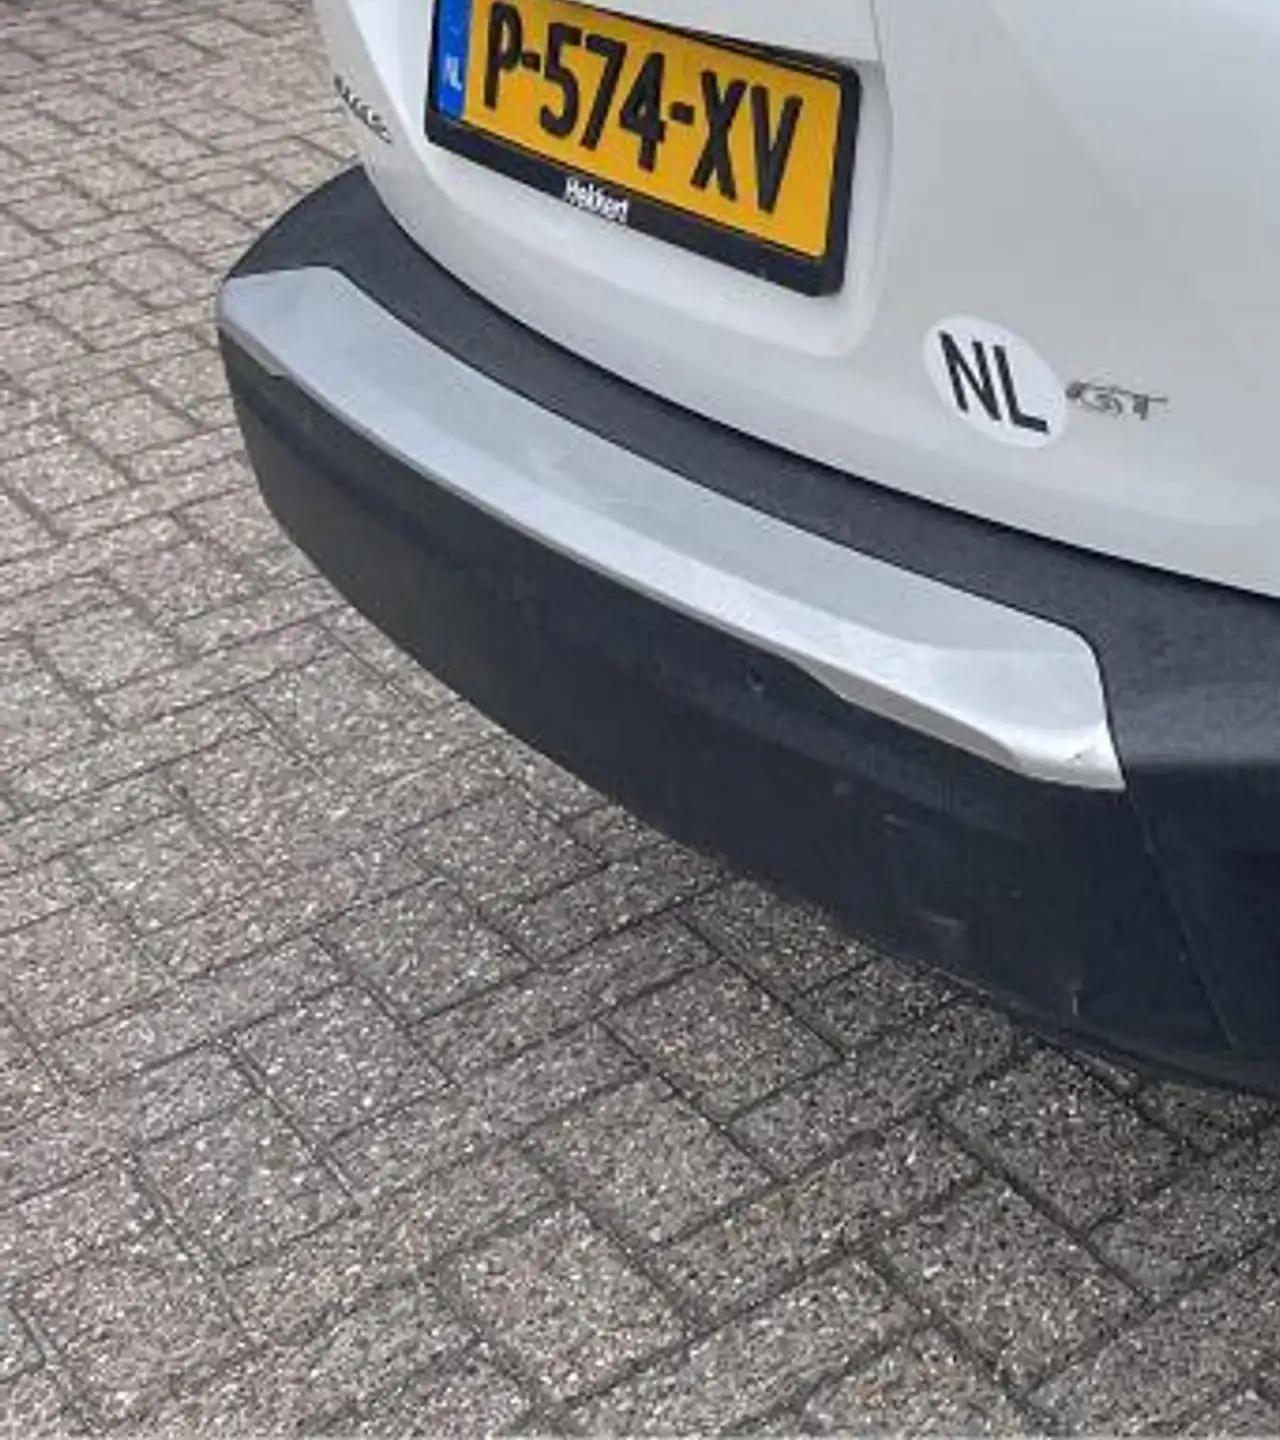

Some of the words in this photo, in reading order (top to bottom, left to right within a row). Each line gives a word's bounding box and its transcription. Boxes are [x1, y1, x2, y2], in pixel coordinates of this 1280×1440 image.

[443, 53, 463, 92] NL
[483, 0, 803, 214] P-574-XV
[938, 329, 1050, 434] NL
